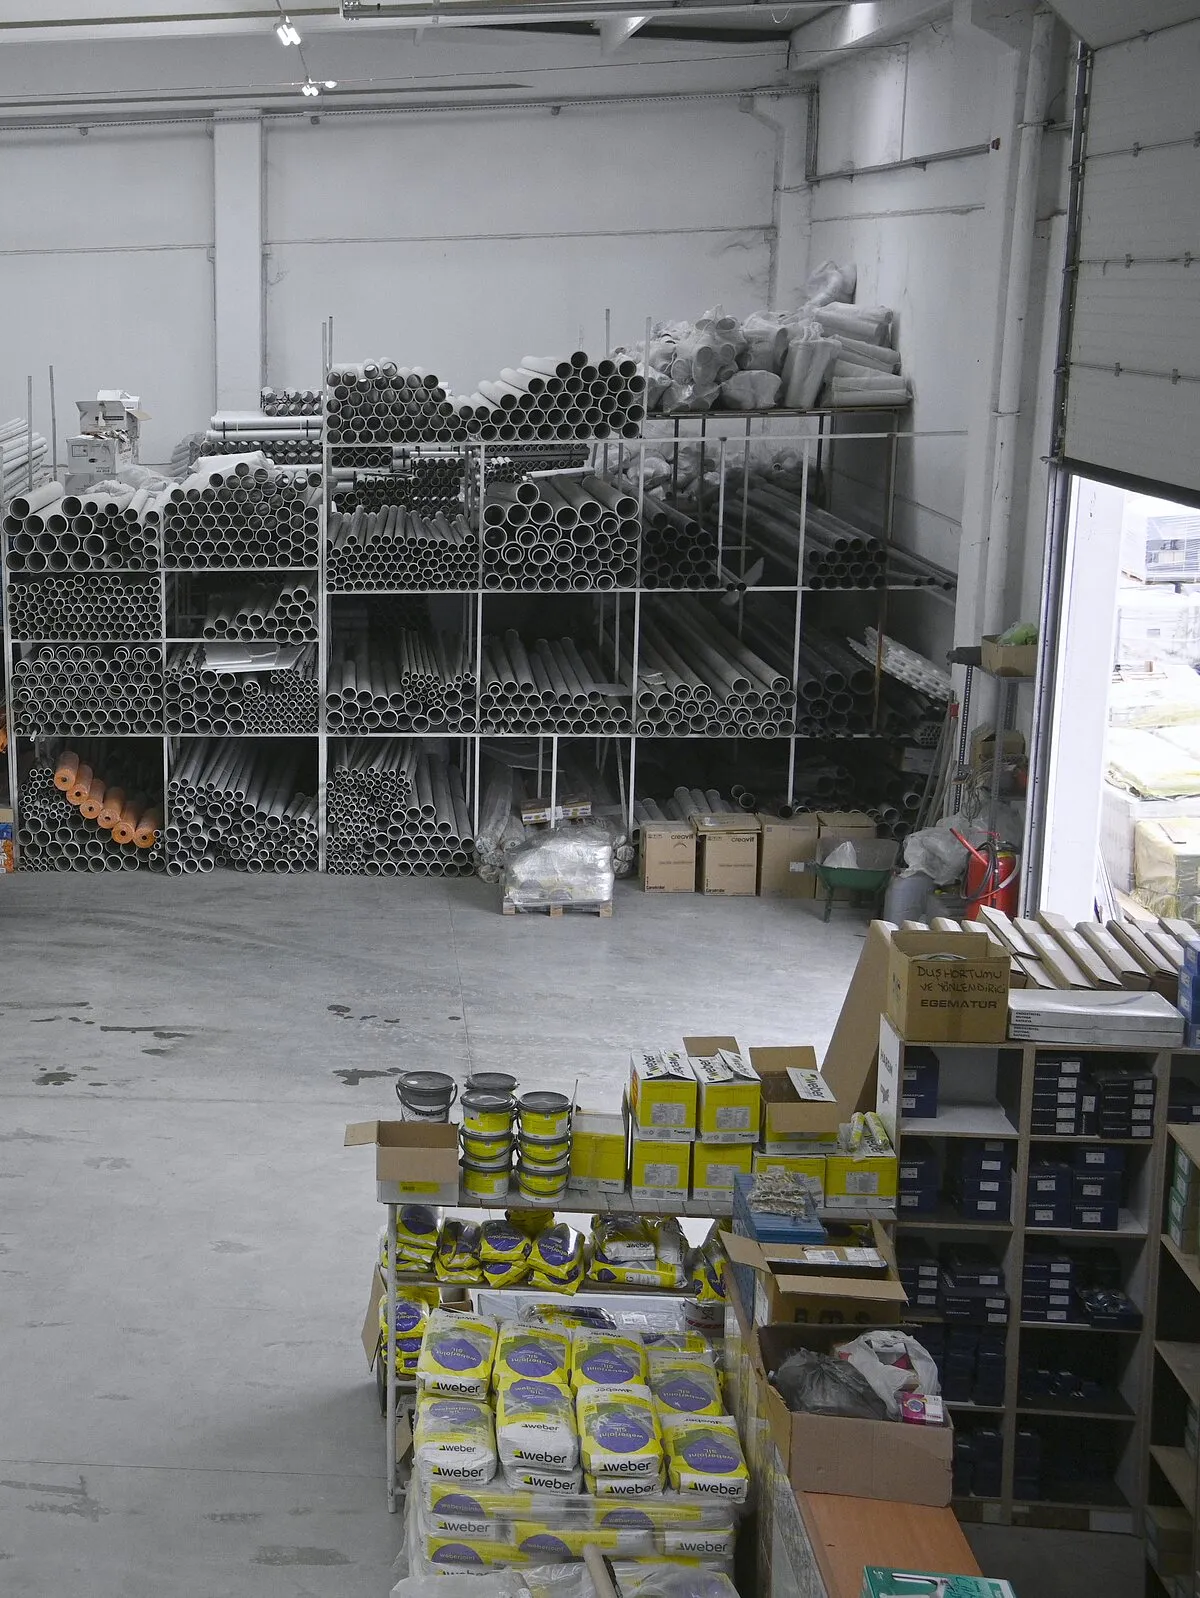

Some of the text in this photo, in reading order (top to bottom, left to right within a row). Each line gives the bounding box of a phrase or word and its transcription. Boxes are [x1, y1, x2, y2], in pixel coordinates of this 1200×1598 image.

[944, 967, 1003, 980] HORTUMU
[920, 983, 933, 992] VE
[920, 999, 998, 1009] EGEMATUR
[436, 1349, 477, 1361] weberjoint
[441, 1382, 480, 1393] weber
[527, 1423, 559, 1431] weber
[600, 1431, 644, 1439] weberjoint
[444, 1444, 477, 1453] weber
[522, 1452, 568, 1464] weber
[689, 1452, 734, 1460] weberjoint
[441, 1466, 484, 1478] weber
[606, 1460, 651, 1472] weber
[532, 1477, 576, 1491] weber
[612, 1483, 656, 1495] weber
[696, 1482, 742, 1496] weber
[447, 1521, 490, 1533] weber
[683, 1540, 728, 1553] weber
